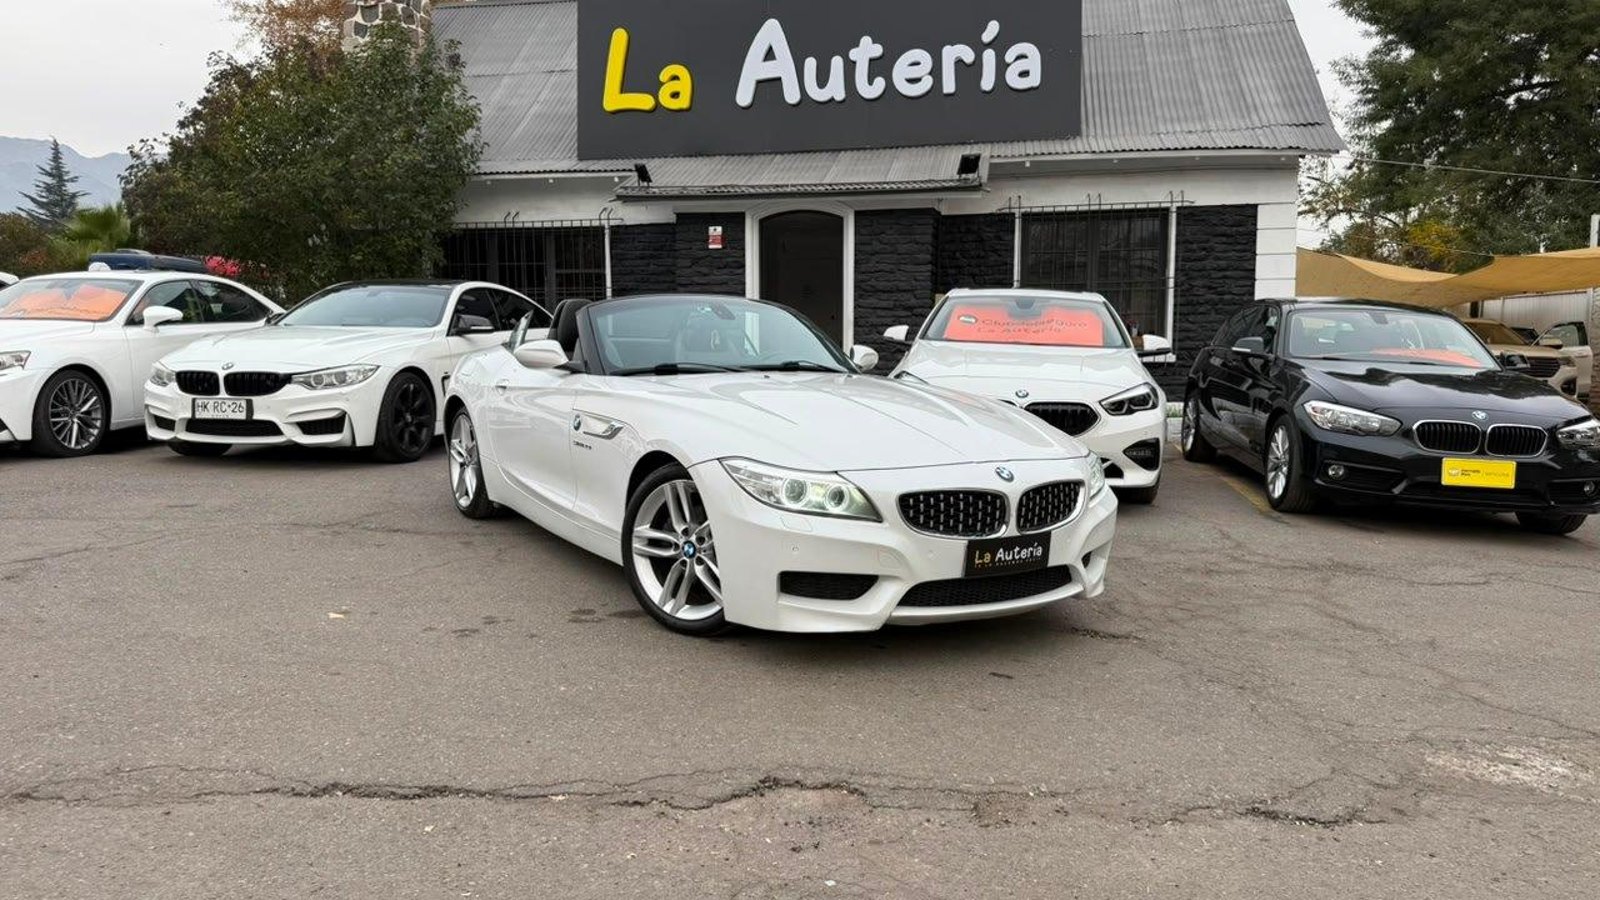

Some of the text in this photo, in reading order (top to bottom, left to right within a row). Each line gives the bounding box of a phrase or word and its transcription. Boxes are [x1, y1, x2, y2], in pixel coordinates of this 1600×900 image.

[602, 18, 1043, 112] La Autería
[975, 550, 991, 564] La
[995, 542, 1043, 561] Autería
